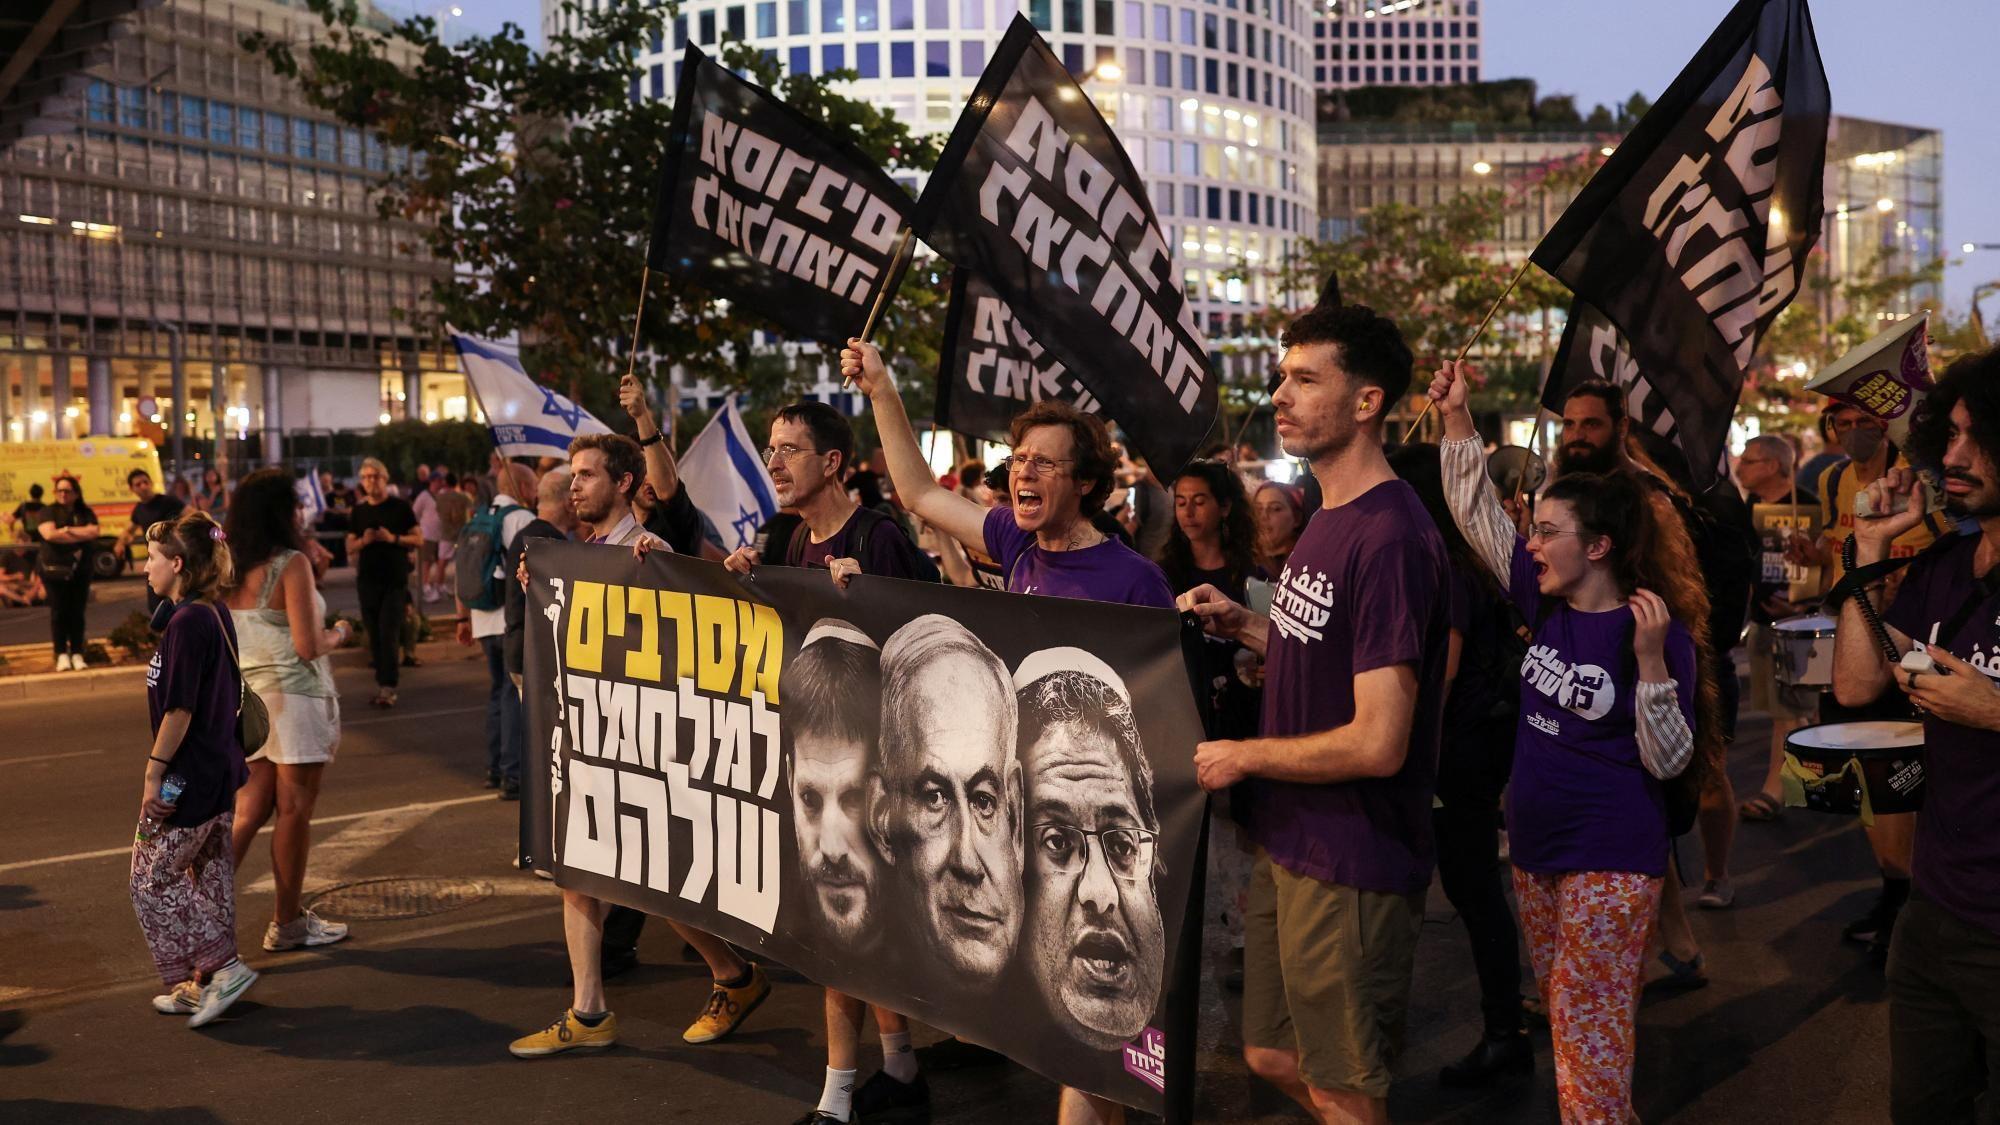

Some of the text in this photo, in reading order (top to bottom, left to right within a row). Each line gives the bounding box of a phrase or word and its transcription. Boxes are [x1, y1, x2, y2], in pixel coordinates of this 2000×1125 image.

[1276, 584, 1331, 627] עומדים
[1291, 565, 1334, 608] نقف
[565, 581, 783, 704] מסרבים
[565, 674, 781, 800] למלחמה
[1891, 773, 1912, 789] כיבוש
[564, 756, 781, 934] שלהם
[1127, 1047, 1165, 1077] ביחד
